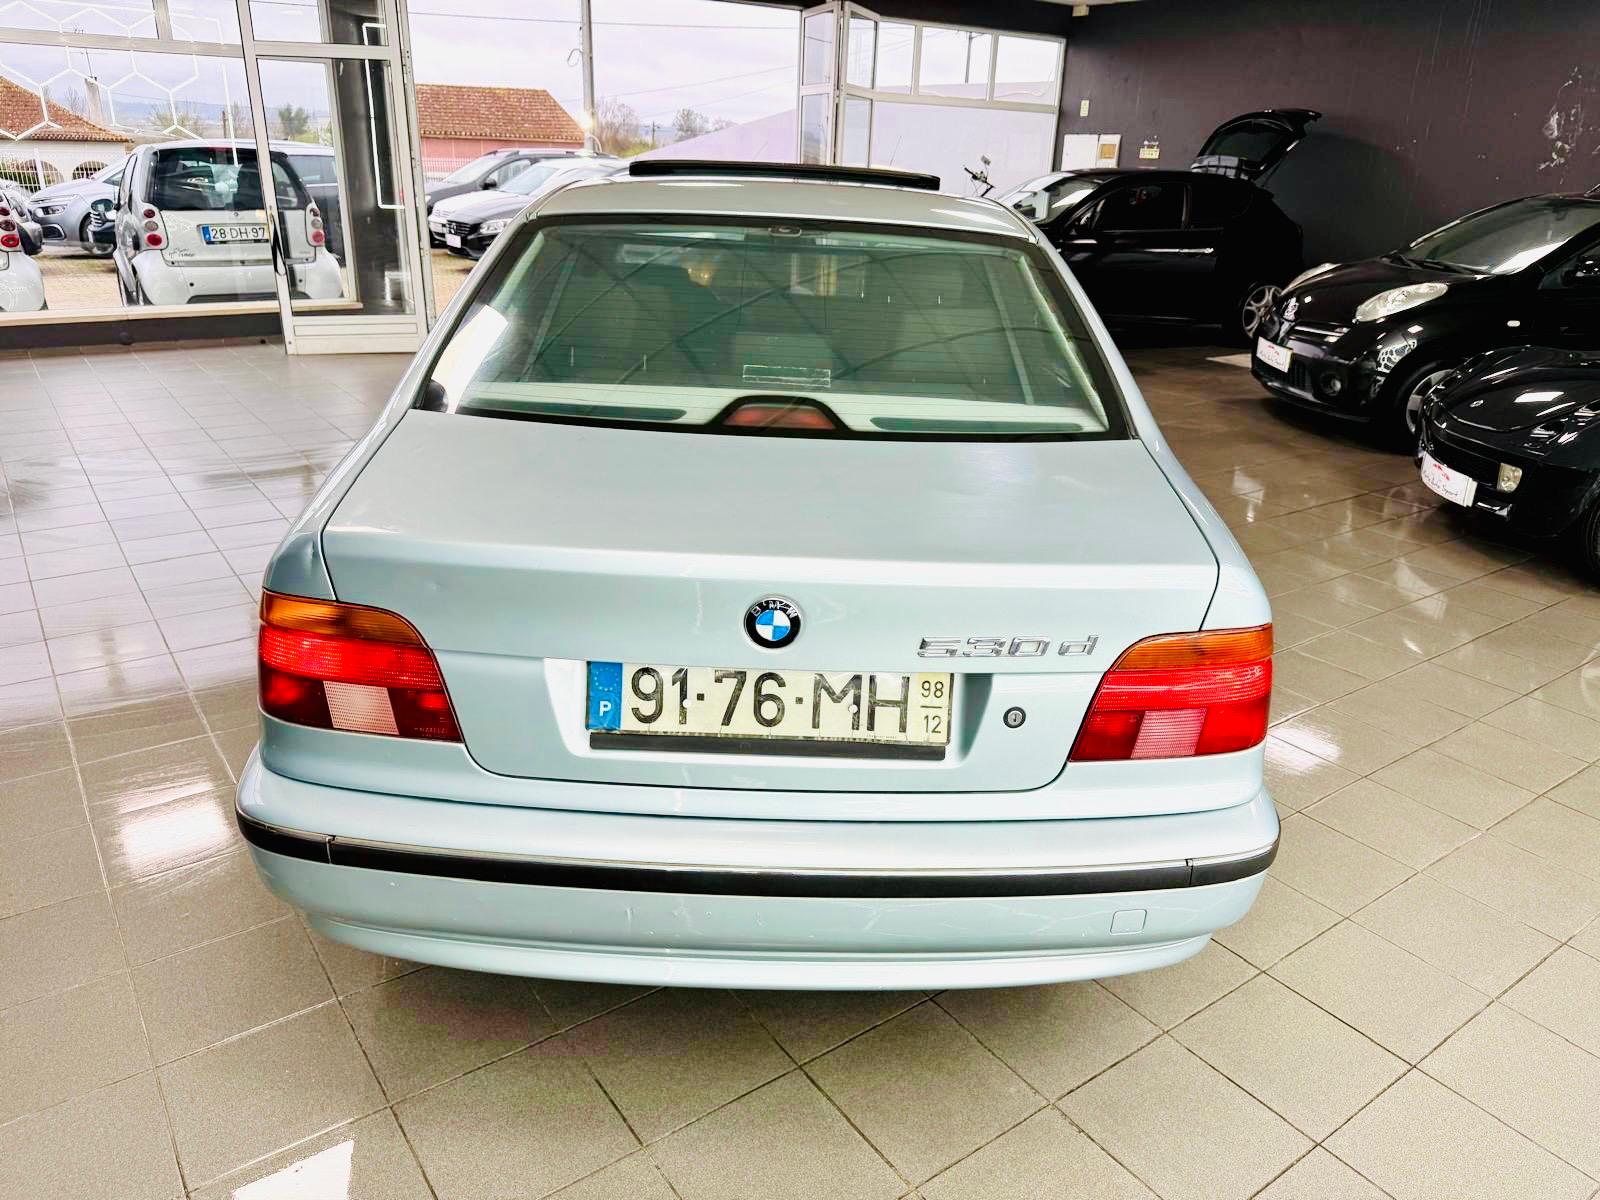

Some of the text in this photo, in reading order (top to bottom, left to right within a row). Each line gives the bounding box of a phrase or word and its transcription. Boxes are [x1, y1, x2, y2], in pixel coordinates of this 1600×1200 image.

[751, 600, 798, 618] BMW
[921, 680, 944, 698] 98
[600, 701, 611, 716] P
[923, 715, 942, 733] 12
